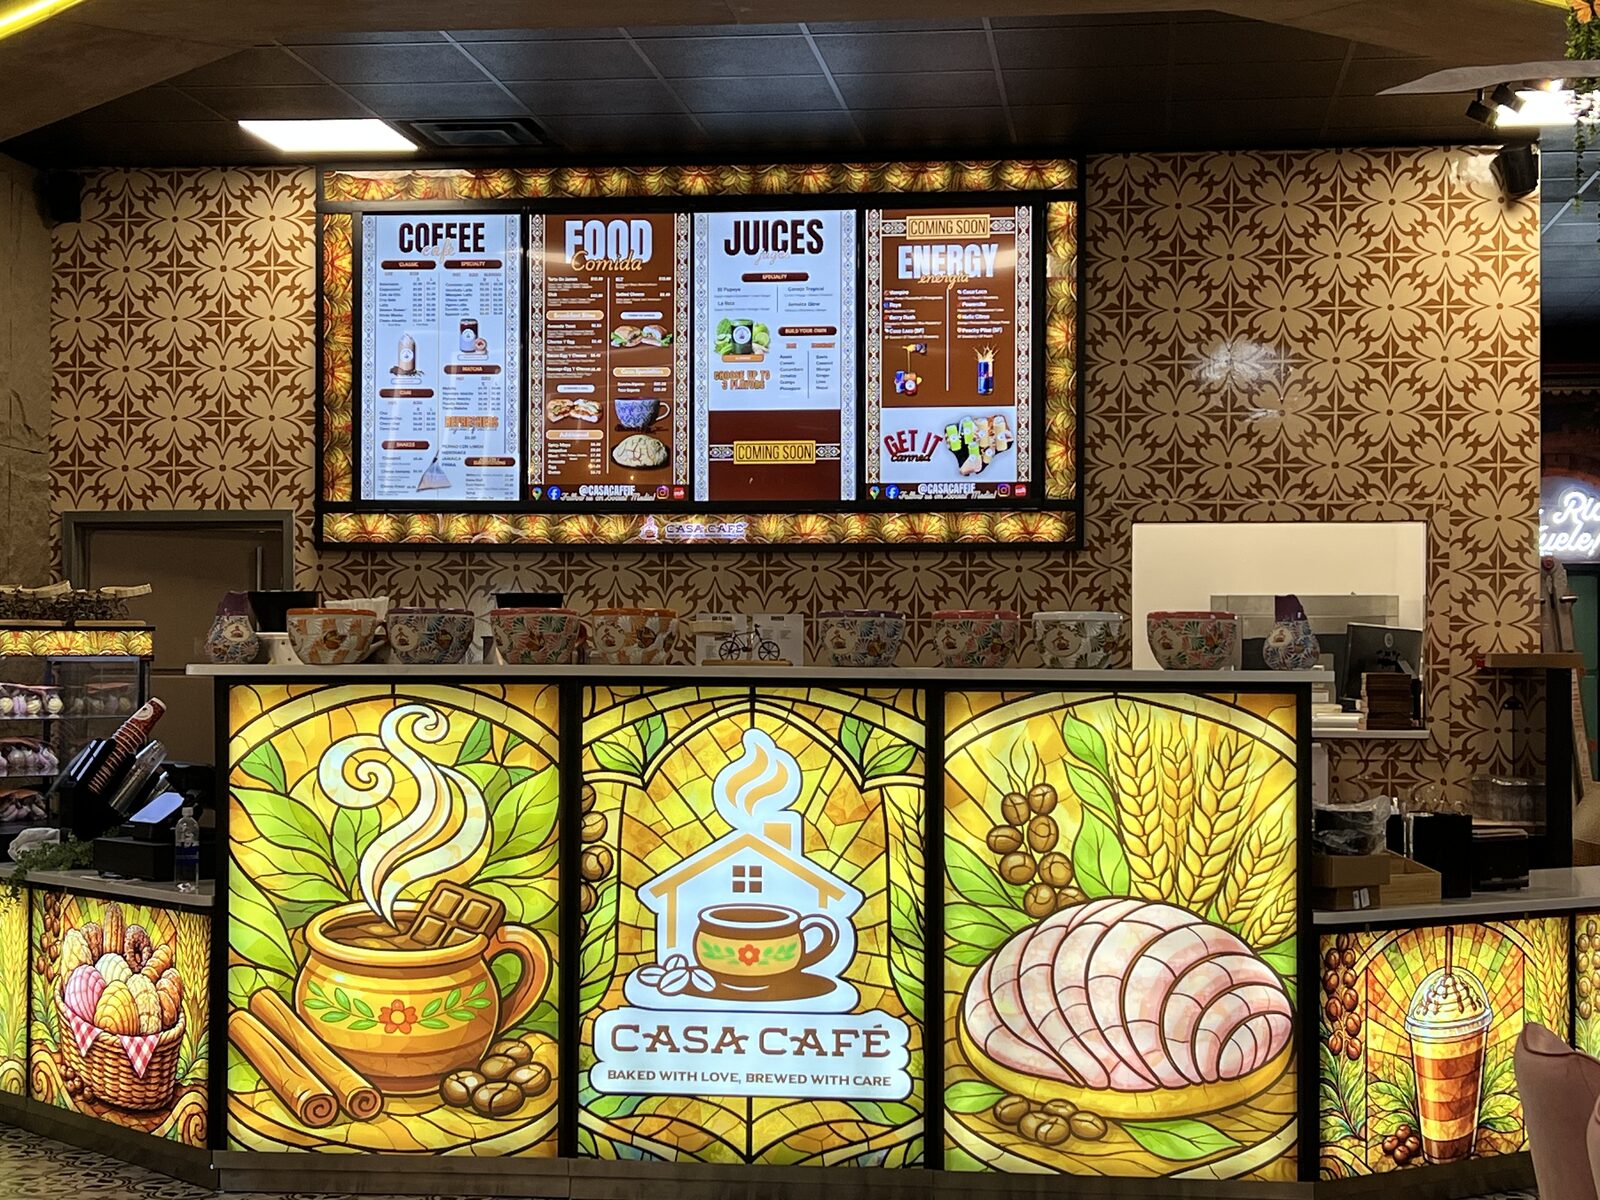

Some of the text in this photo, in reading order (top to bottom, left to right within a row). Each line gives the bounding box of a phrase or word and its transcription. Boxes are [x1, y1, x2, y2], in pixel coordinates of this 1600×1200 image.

[399, 223, 485, 253] COFFEE
[724, 219, 824, 256] JUICES
[910, 219, 986, 235] COMING SOON
[565, 219, 653, 264] FOOD
[571, 249, 643, 271] Comida
[898, 243, 999, 279] ENERGY
[713, 369, 771, 380] CHOOSE UP TO
[738, 444, 812, 460] COMING SOON
[883, 430, 943, 457] GET IT
[666, 524, 704, 533] CASA
[611, 1024, 891, 1058] CASA CAFÉ
[607, 1069, 892, 1087] BAKED WITH LOVE, BREWED WITH CARE
